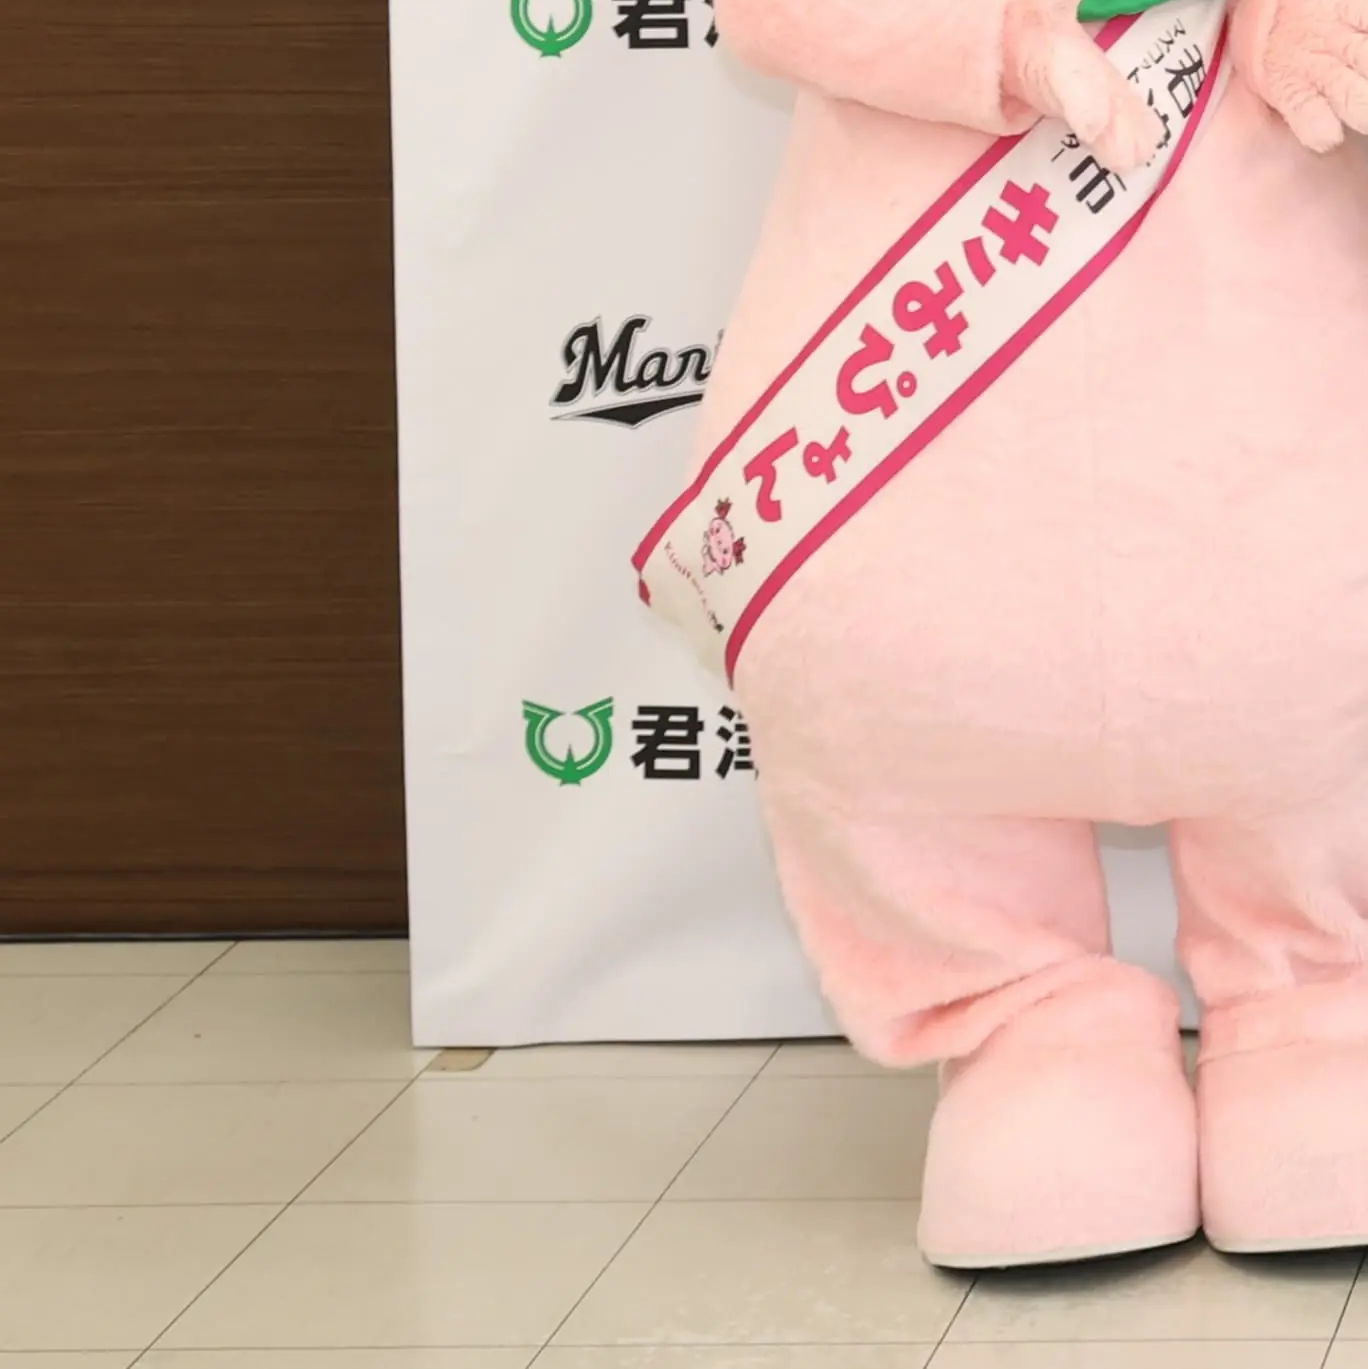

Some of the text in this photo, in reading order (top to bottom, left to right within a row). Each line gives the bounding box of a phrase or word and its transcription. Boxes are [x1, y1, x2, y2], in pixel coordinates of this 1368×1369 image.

[743, 178, 1060, 523] きみぴょん
